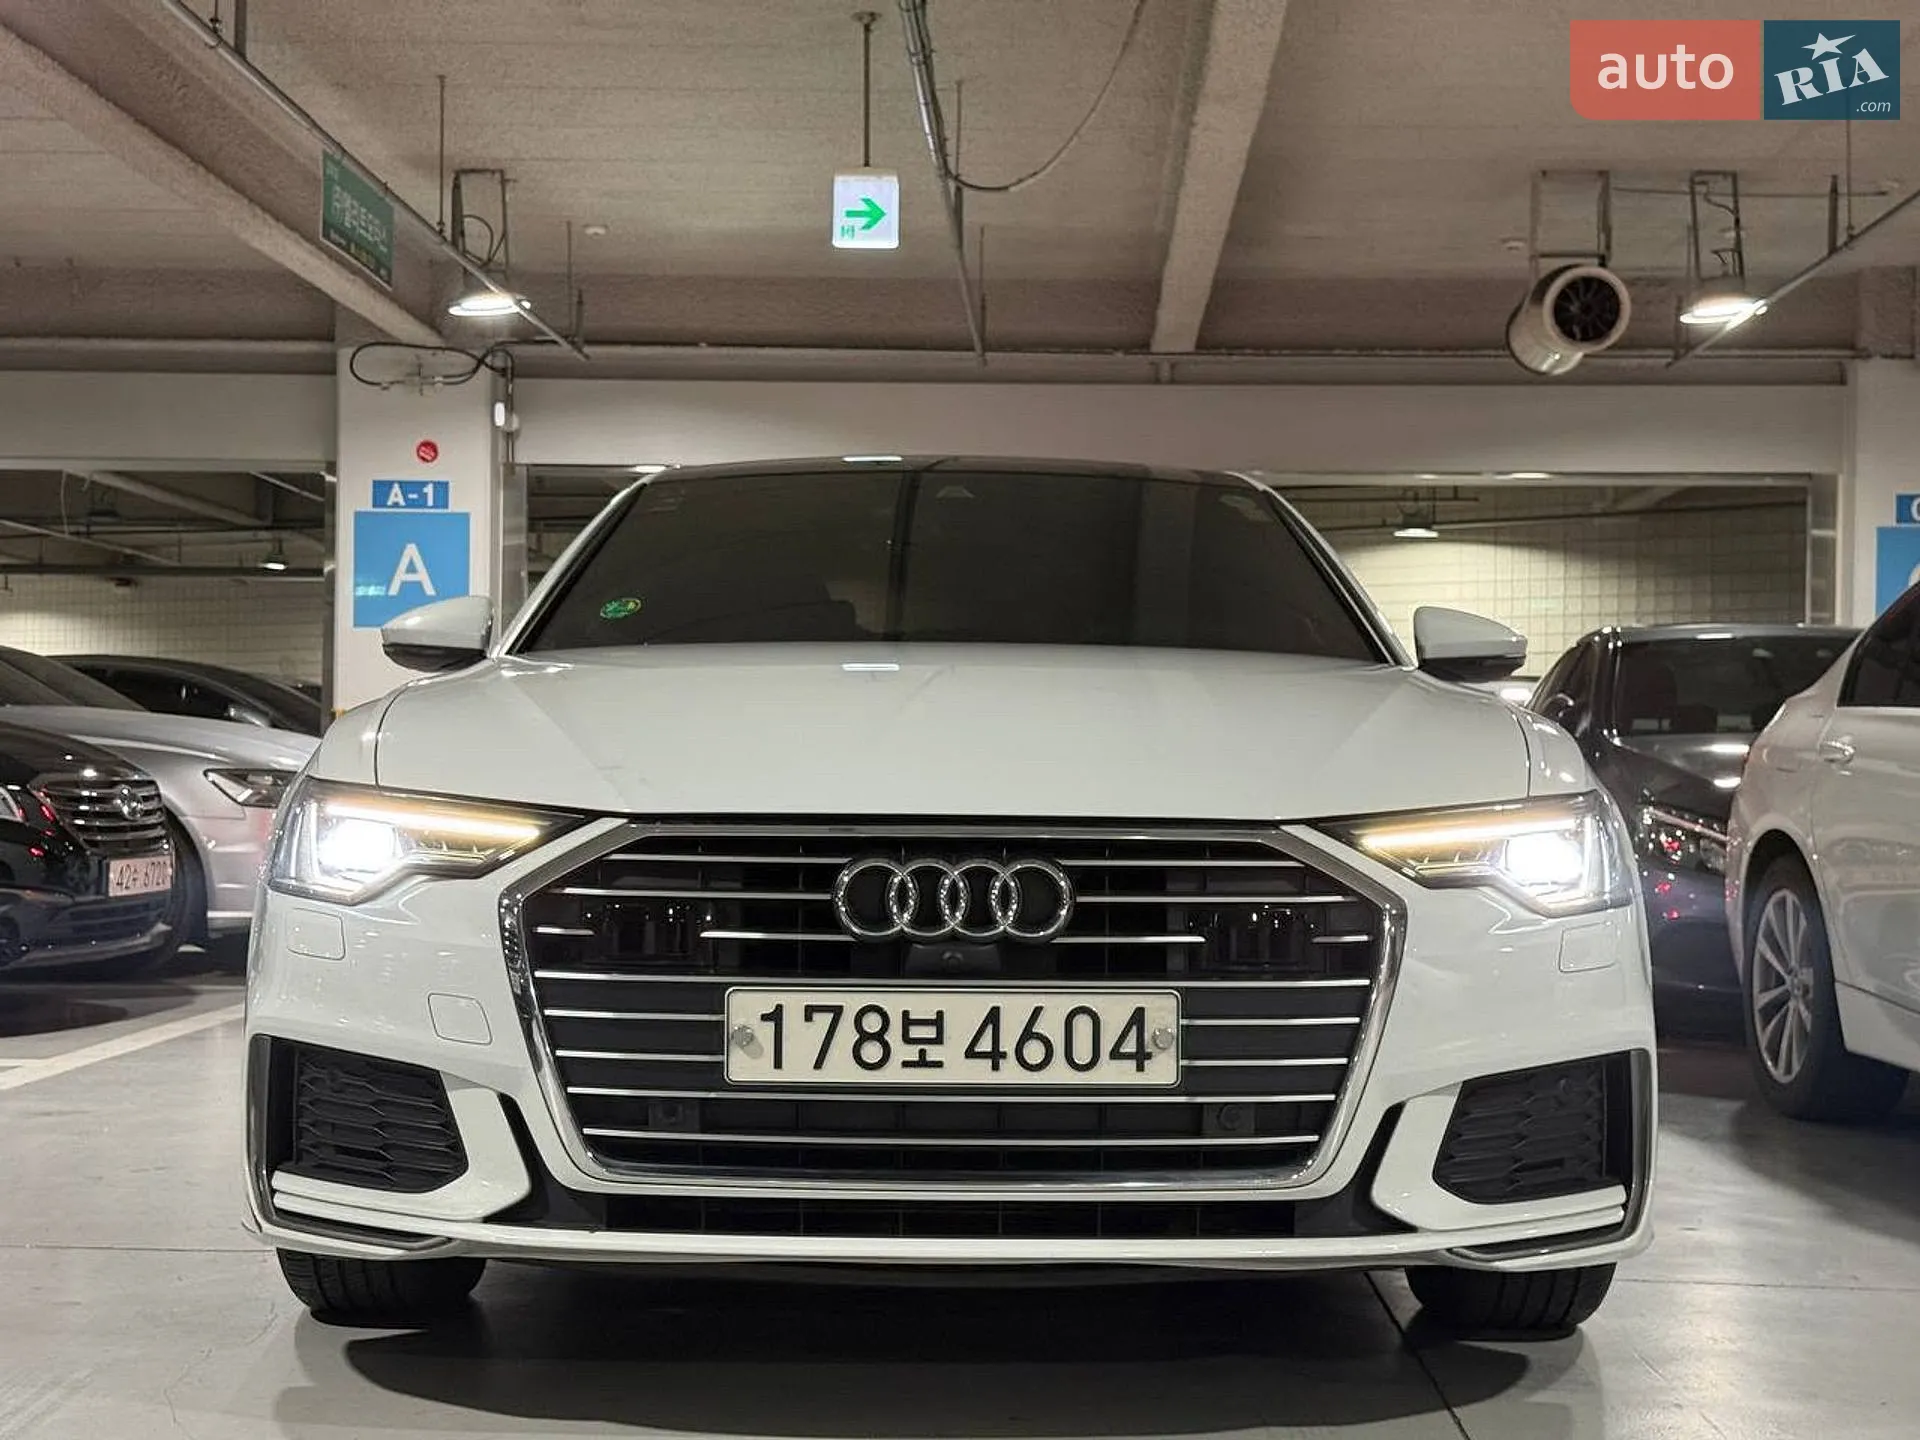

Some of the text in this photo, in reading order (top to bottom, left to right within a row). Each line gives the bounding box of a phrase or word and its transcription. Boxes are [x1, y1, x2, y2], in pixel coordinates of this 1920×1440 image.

[386, 482, 435, 507] A-1
[387, 543, 437, 596] A
[760, 1003, 1153, 1073] 178보 4604
